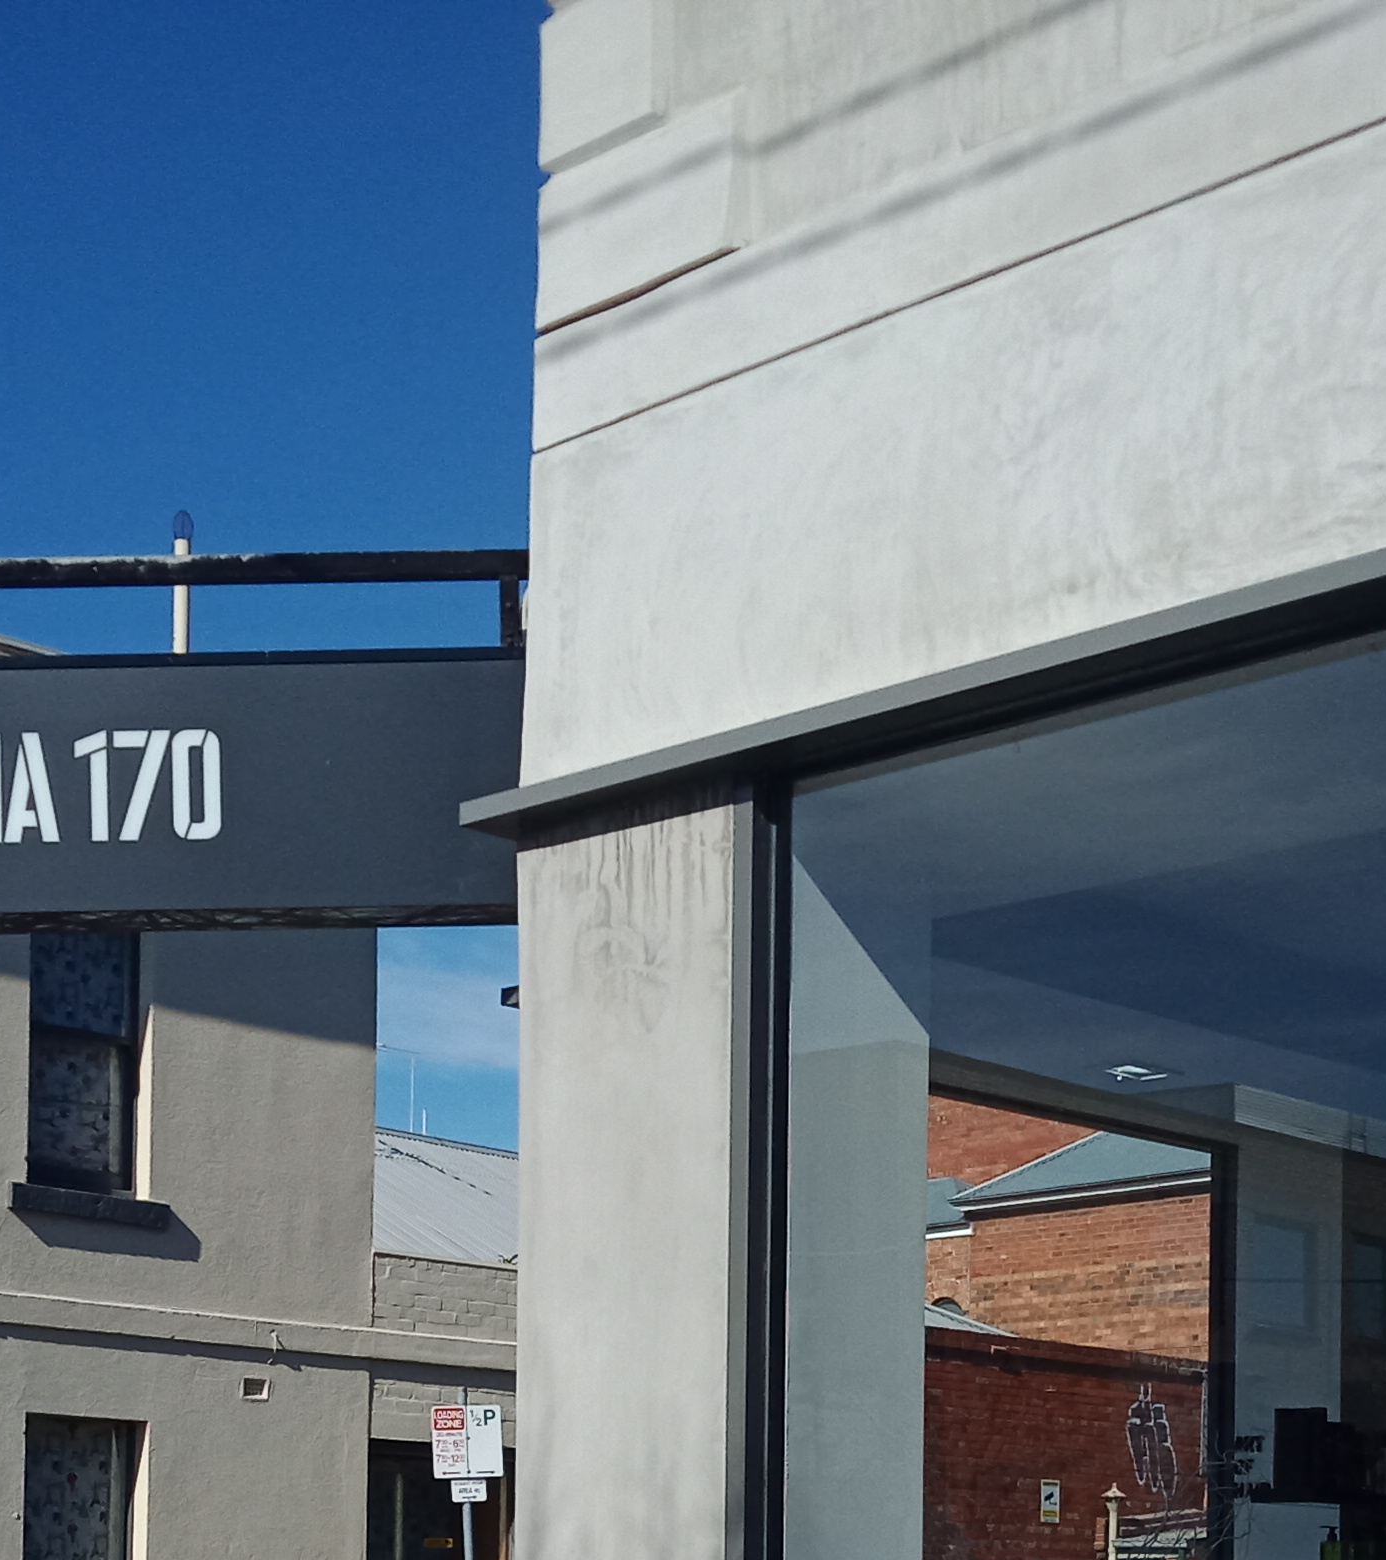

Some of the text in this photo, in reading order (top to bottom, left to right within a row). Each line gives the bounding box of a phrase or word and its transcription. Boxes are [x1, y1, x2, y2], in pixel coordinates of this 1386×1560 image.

[73, 728, 223, 843] 170
[433, 1410, 464, 1419] LOADING
[436, 1419, 463, 1429] ZONE
